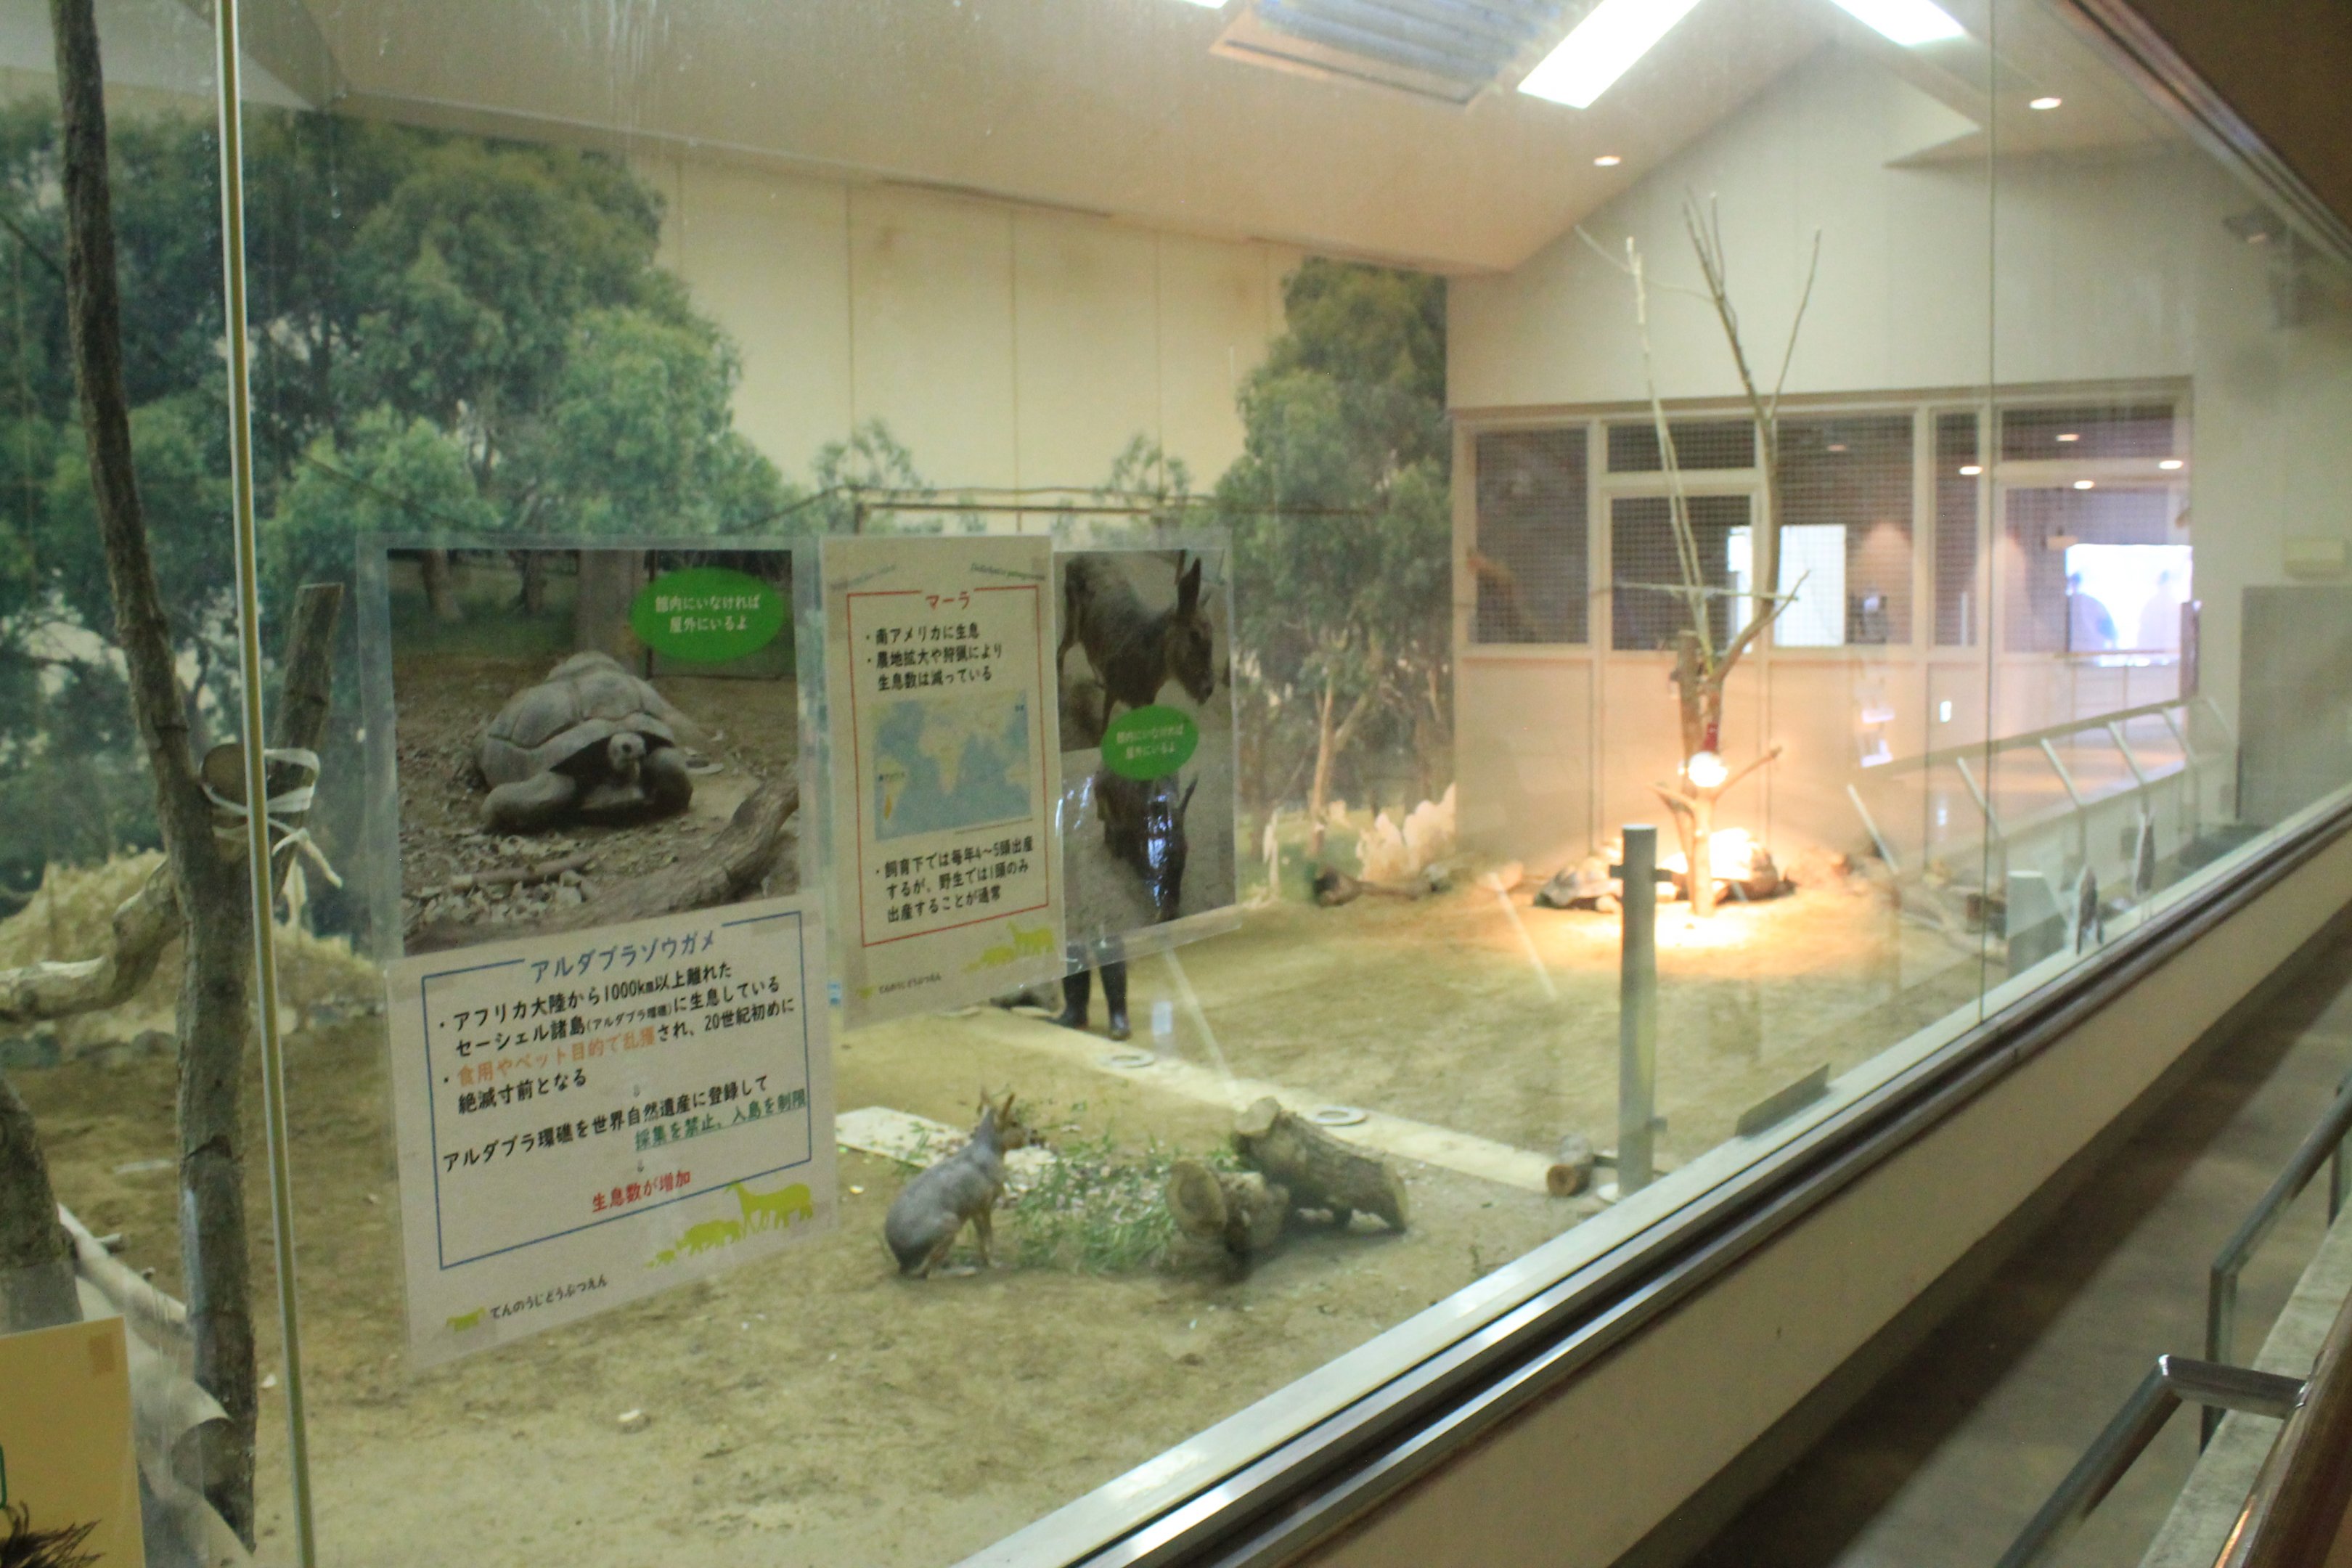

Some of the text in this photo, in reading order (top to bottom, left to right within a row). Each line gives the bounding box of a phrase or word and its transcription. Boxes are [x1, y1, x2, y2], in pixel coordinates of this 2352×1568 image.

[926, 591, 971, 611] マーラ
[875, 621, 980, 645] 南アメリカに生息
[531, 930, 714, 984] アルダブラゾウガメ
[458, 1066, 587, 1114] 絶滅寸前となる
[592, 1169, 692, 1213] 生息数が増加
